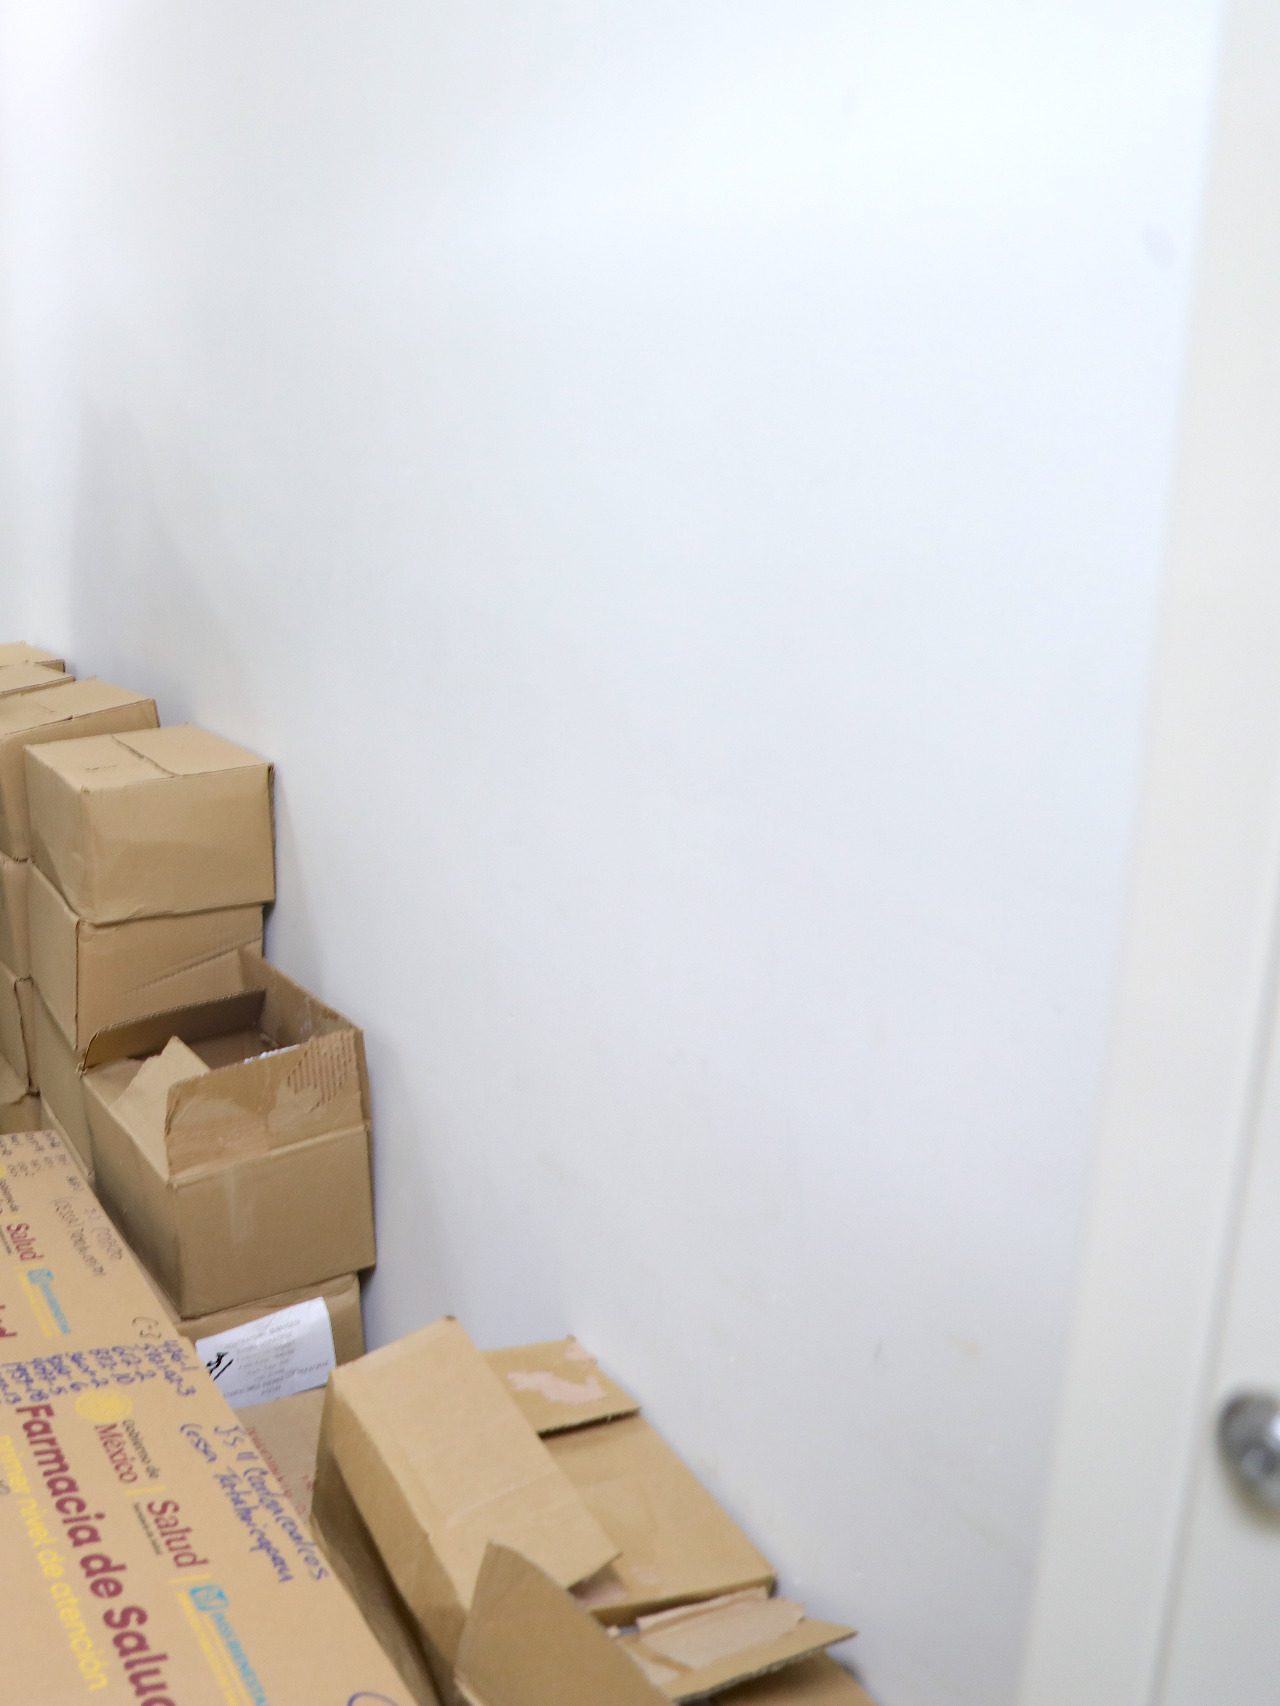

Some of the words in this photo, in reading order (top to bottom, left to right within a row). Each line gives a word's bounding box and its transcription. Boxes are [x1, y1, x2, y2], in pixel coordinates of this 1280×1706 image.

[6, 1222, 45, 1261] Salud
[94, 1423, 138, 1483] México
[15, 1403, 106, 1548] Farmacia
[79, 1553, 127, 1599] de
[147, 1500, 210, 1568] Salud
